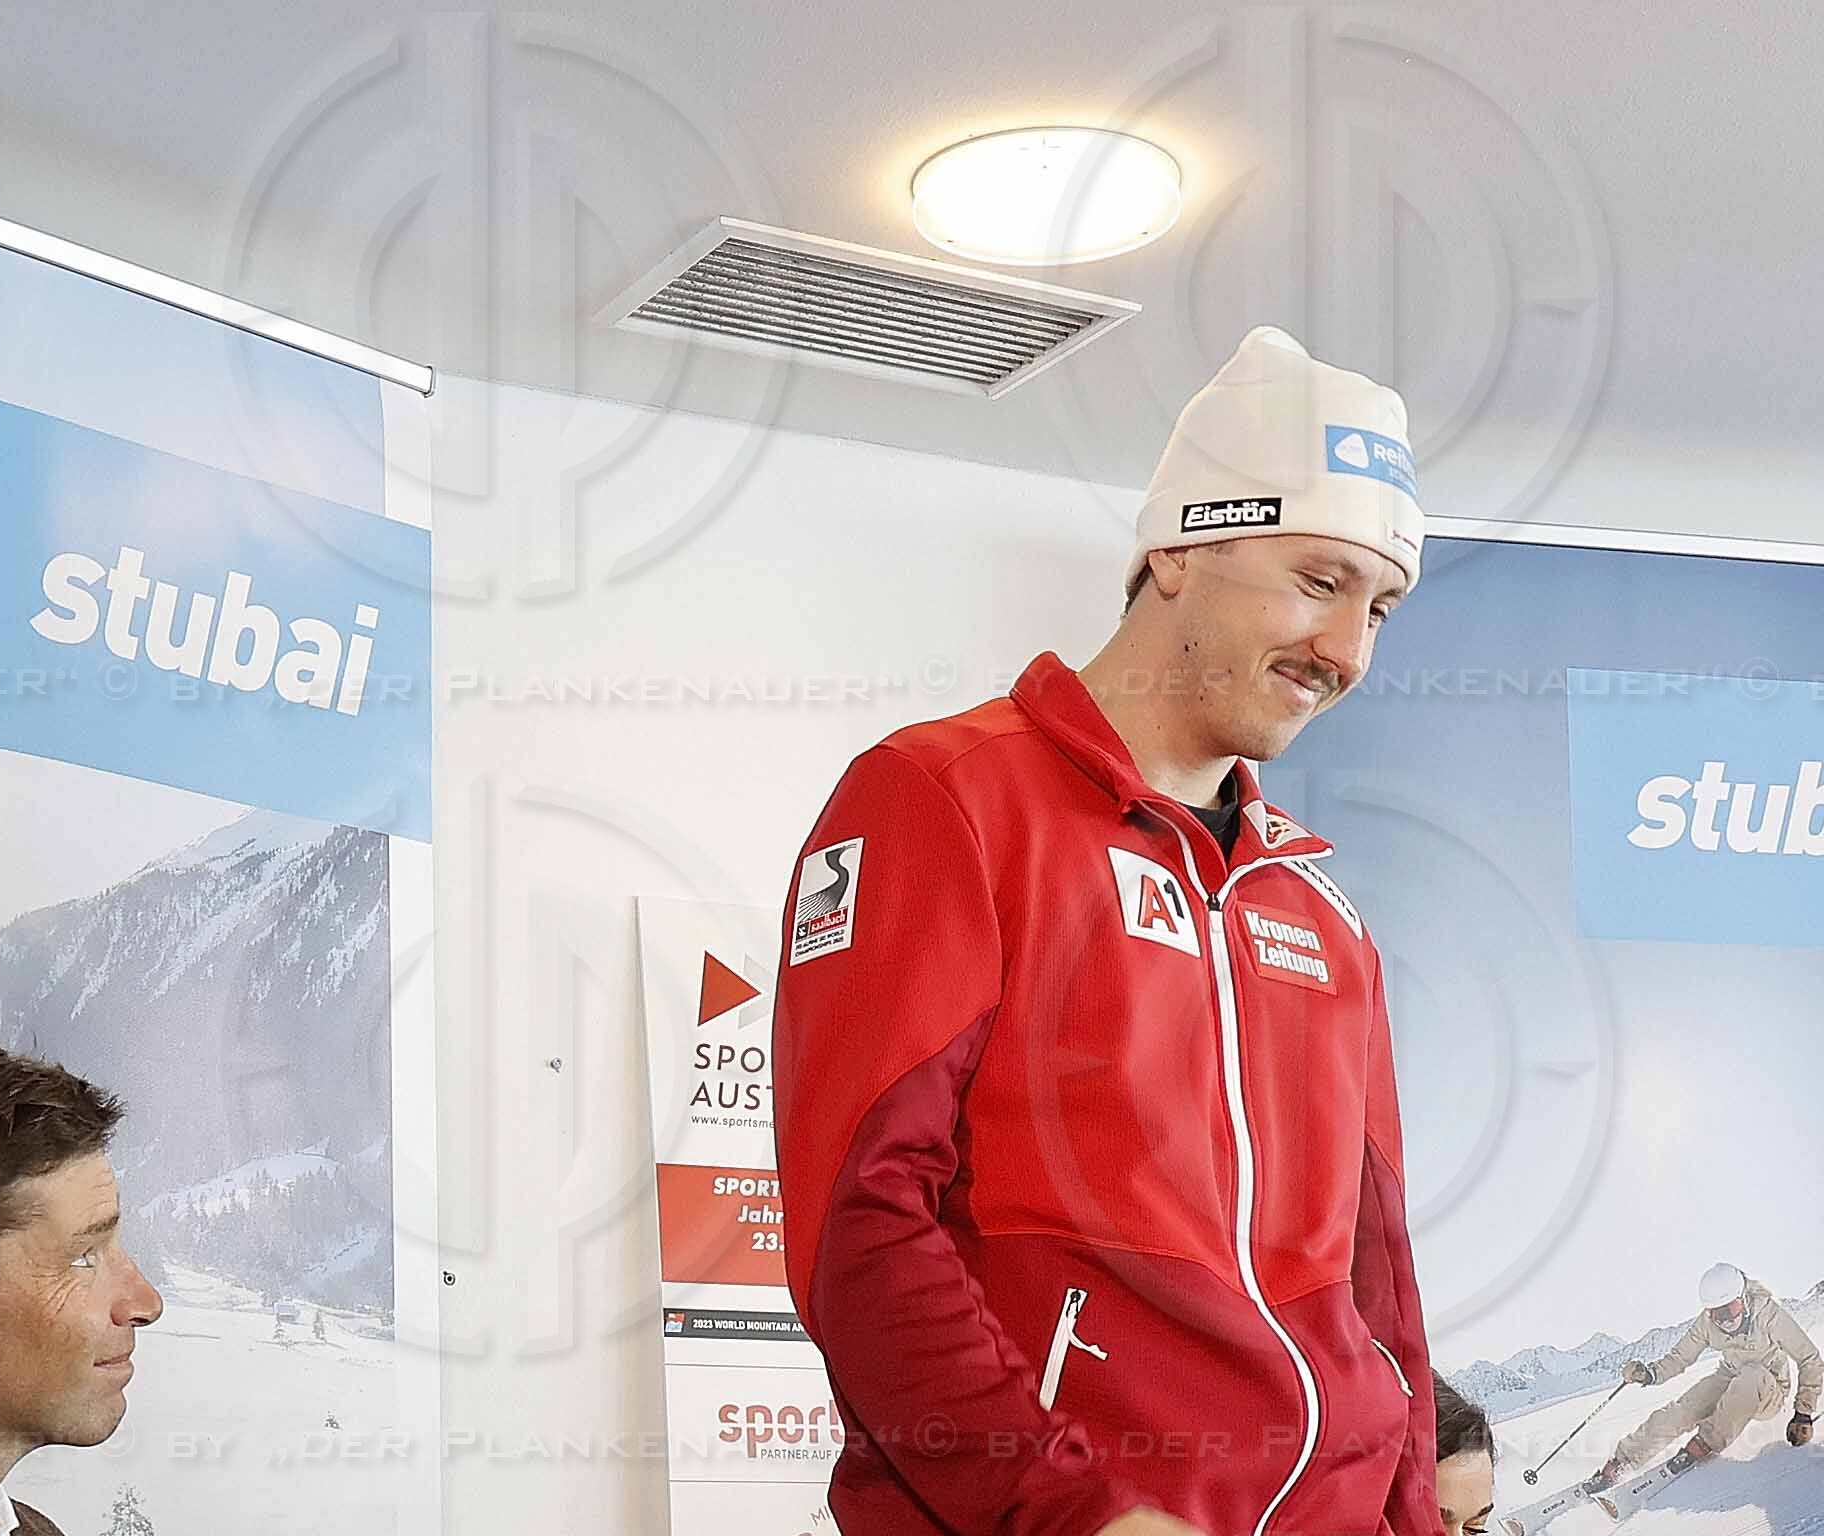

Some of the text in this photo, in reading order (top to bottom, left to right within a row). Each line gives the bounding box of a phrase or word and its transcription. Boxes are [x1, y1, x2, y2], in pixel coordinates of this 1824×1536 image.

[1183, 501, 1277, 528] Eisbär
[28, 546, 379, 717] stubai
[1138, 874, 1185, 934] A1
[1243, 910, 1321, 952] Kronen
[1253, 939, 1329, 983] Zeitung
[694, 1043, 766, 1073] SPO
[691, 1115, 775, 1129] www.sportsme
[713, 1177, 780, 1198] SPORT
[737, 1205, 784, 1224] Jahr
[692, 1319, 805, 1333] 2023 WORLD MOUNTAIN AN
[718, 1400, 844, 1458] sport
[761, 1449, 809, 1459] PARTNER
[811, 1450, 832, 1459] AUF
